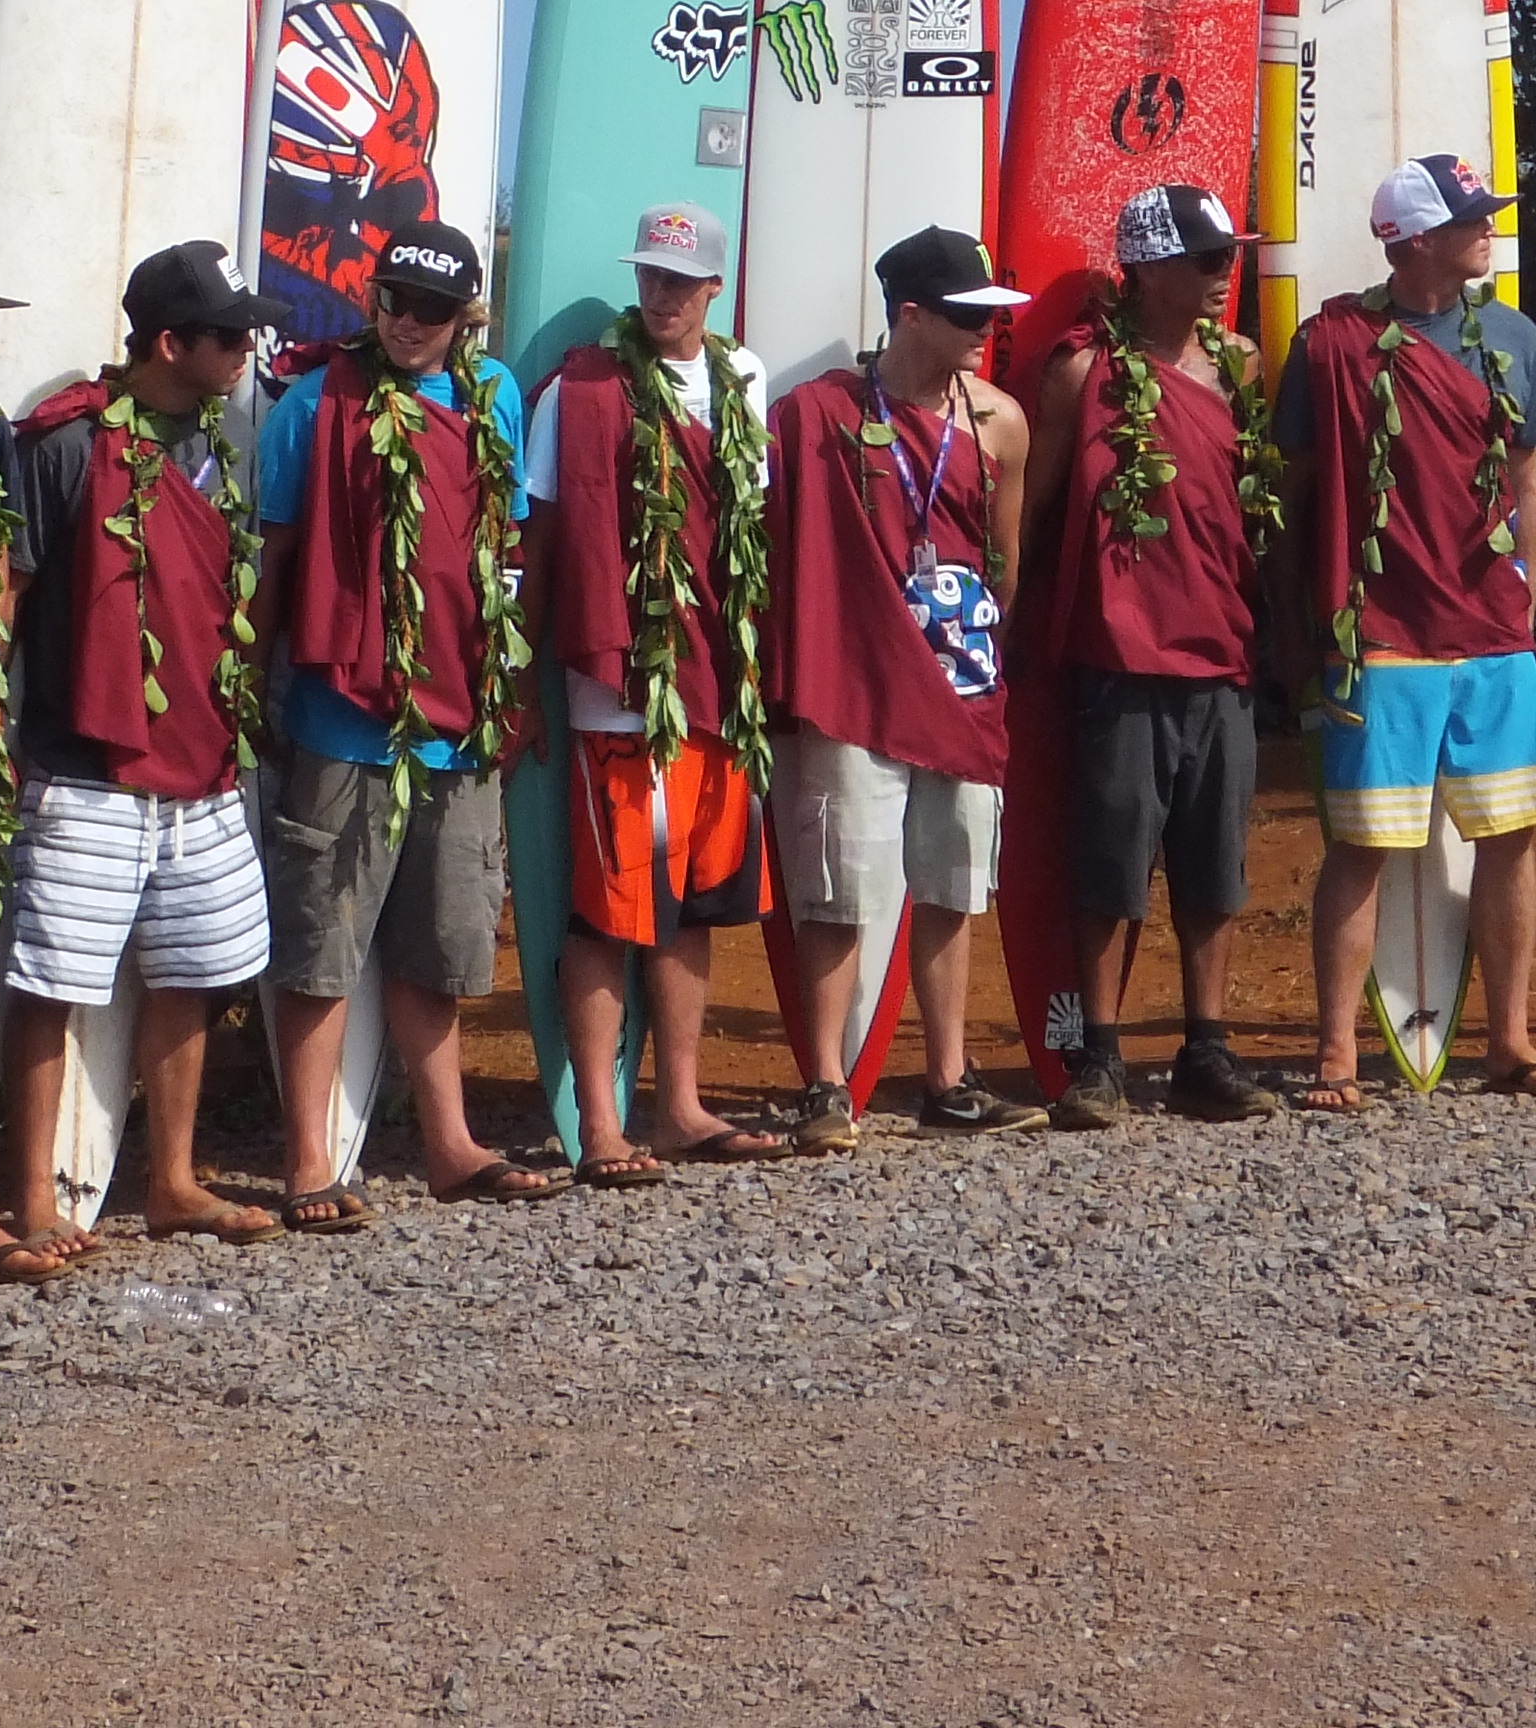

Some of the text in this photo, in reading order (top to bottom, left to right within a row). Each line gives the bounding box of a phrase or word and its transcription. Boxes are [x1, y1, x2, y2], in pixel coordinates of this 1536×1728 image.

[910, 29, 968, 41] FOREVER
[906, 79, 993, 94] OAKLEY
[1299, 38, 1318, 191] DAKINE
[390, 244, 464, 278] OAKLEY
